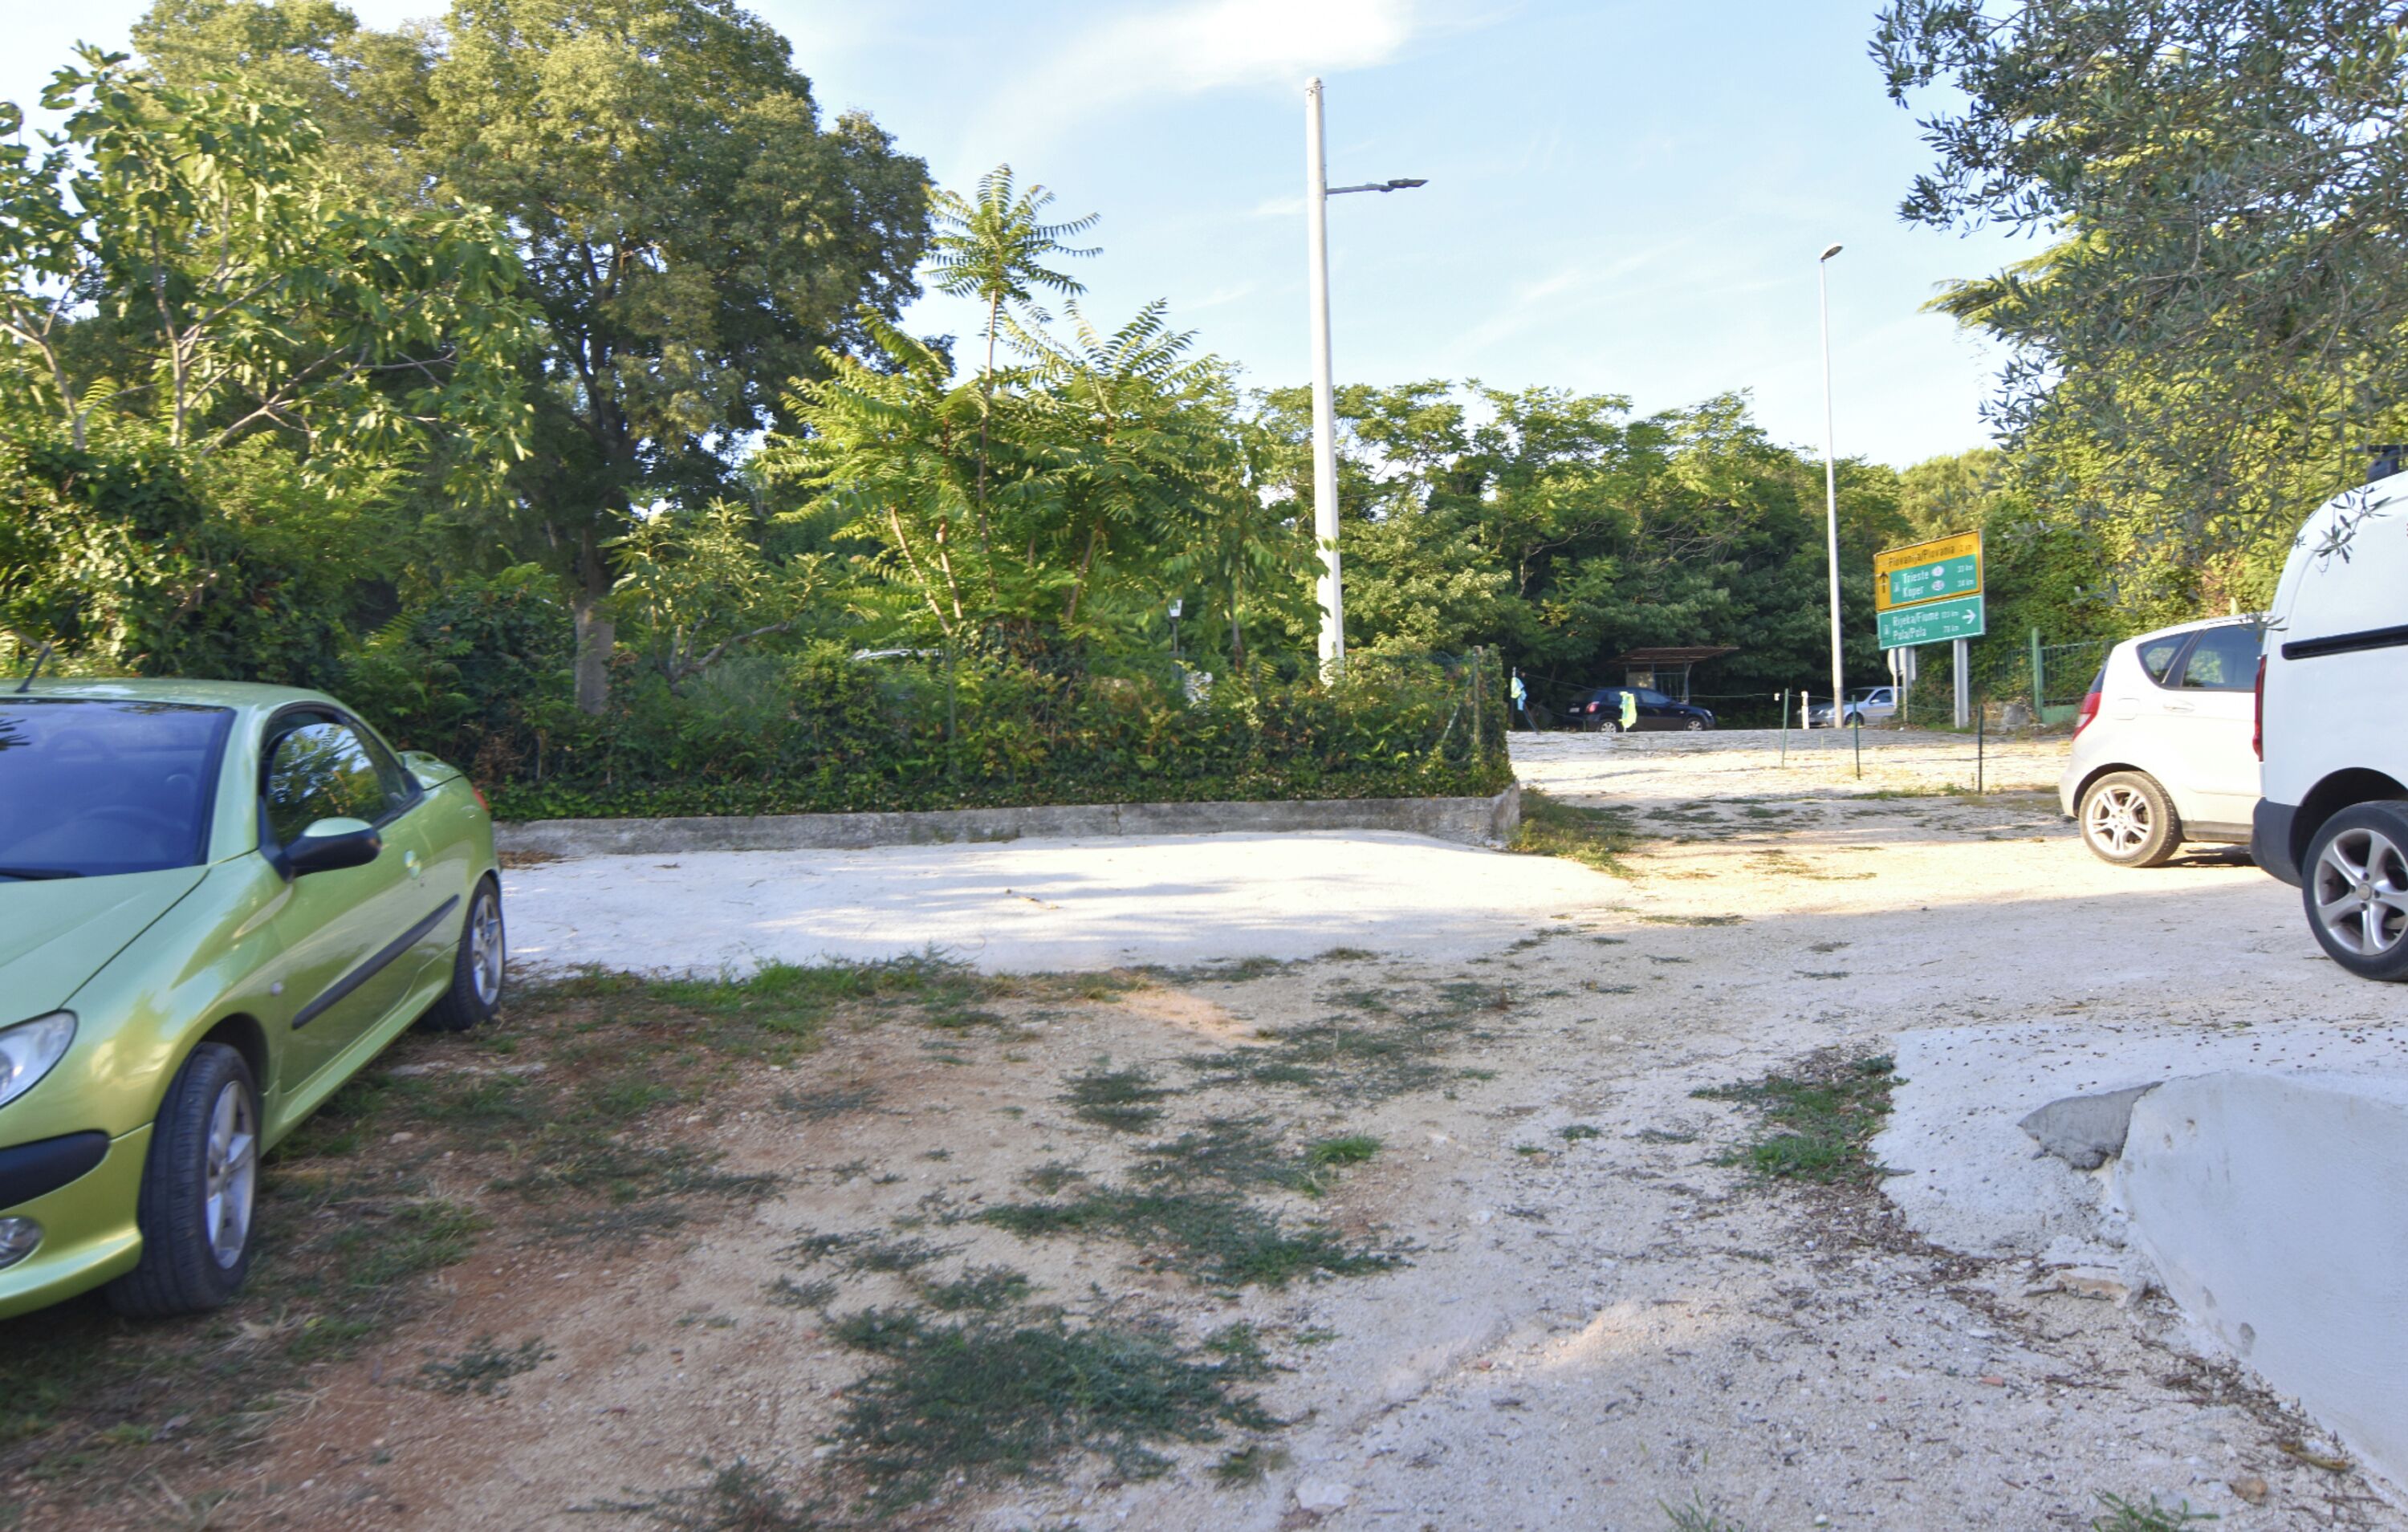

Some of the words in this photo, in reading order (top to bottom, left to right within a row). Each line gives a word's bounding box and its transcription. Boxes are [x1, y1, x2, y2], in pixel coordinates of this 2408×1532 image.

[1902, 571, 1929, 584] Trieste
[1902, 586, 1924, 599] Koper
[1893, 612, 1939, 628] Rijeka/Fiume
